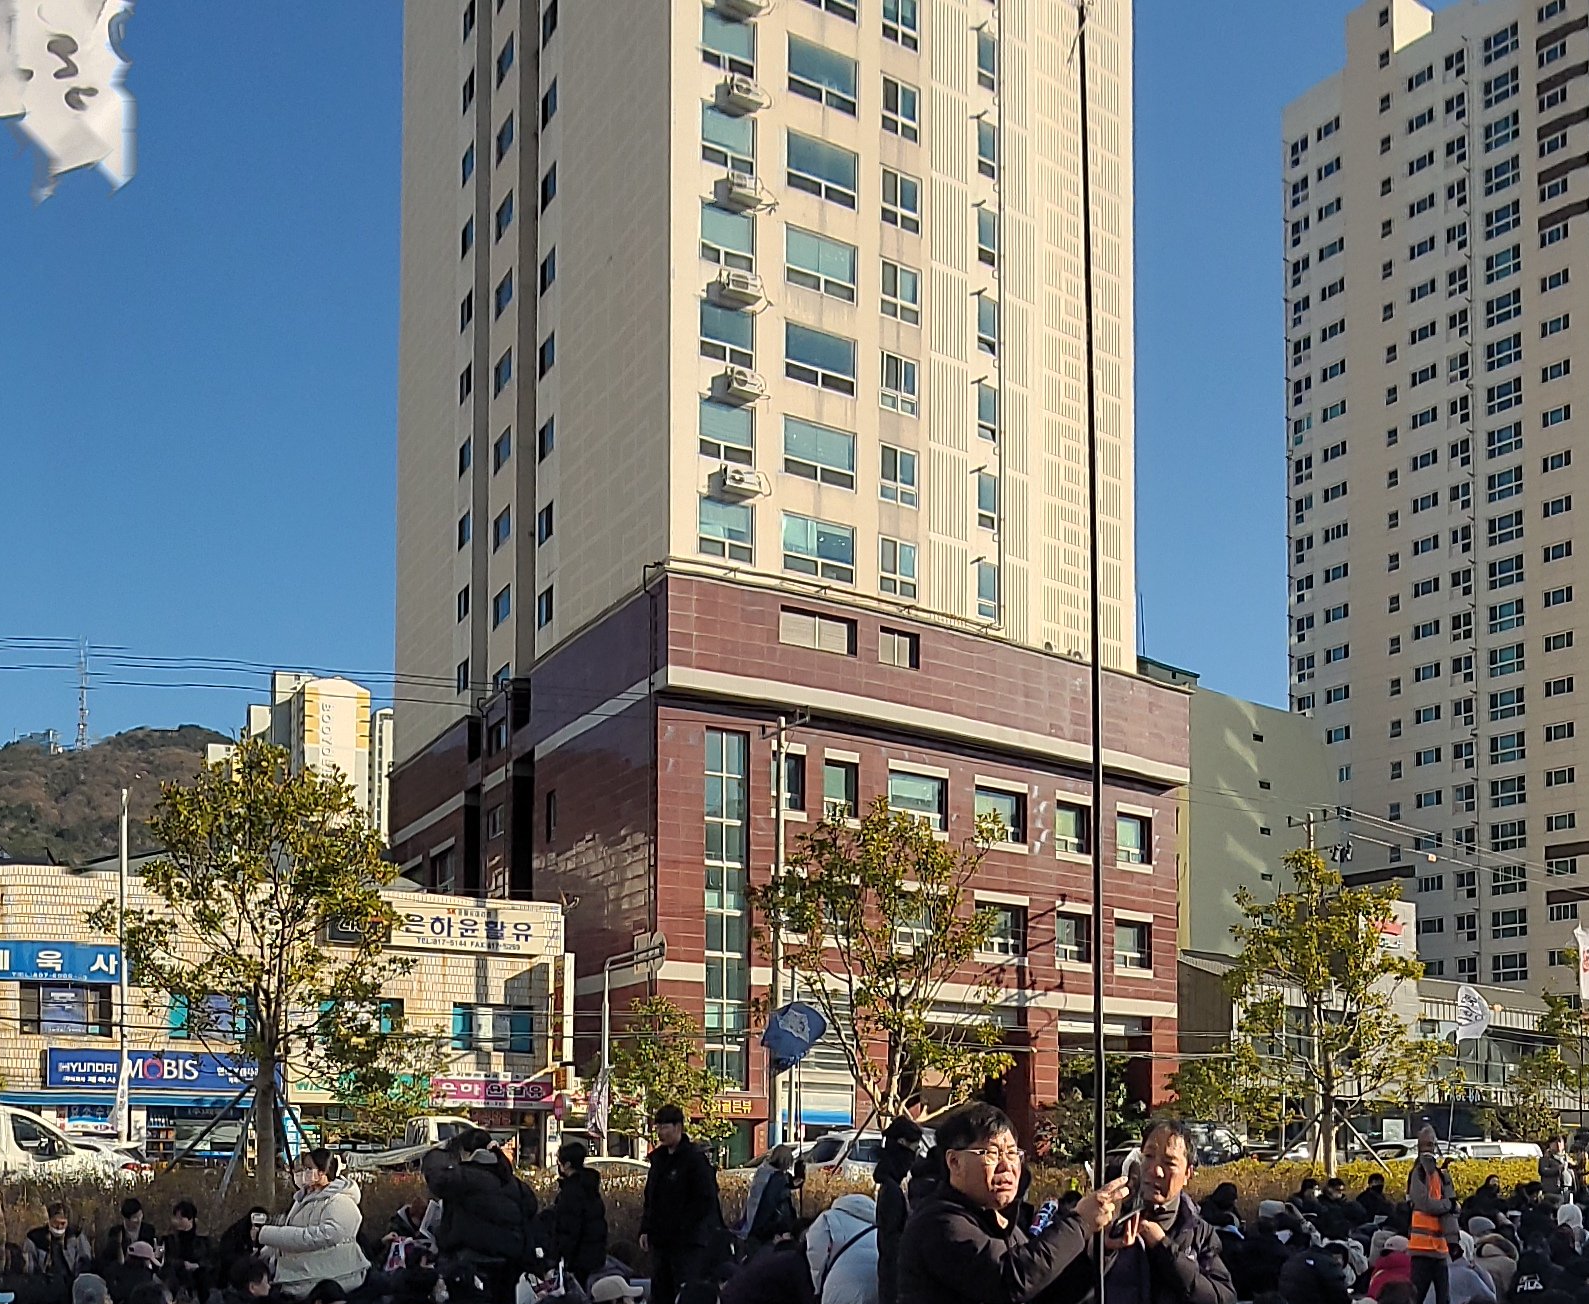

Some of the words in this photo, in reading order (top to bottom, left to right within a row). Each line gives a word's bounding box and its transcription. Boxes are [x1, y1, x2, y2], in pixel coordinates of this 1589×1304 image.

[403, 912, 533, 943] 은하윤활유
[57, 1061, 119, 1074] HYUNDAI
[128, 1057, 200, 1082] MOBIS
[1516, 1280, 1544, 1293] FILA
